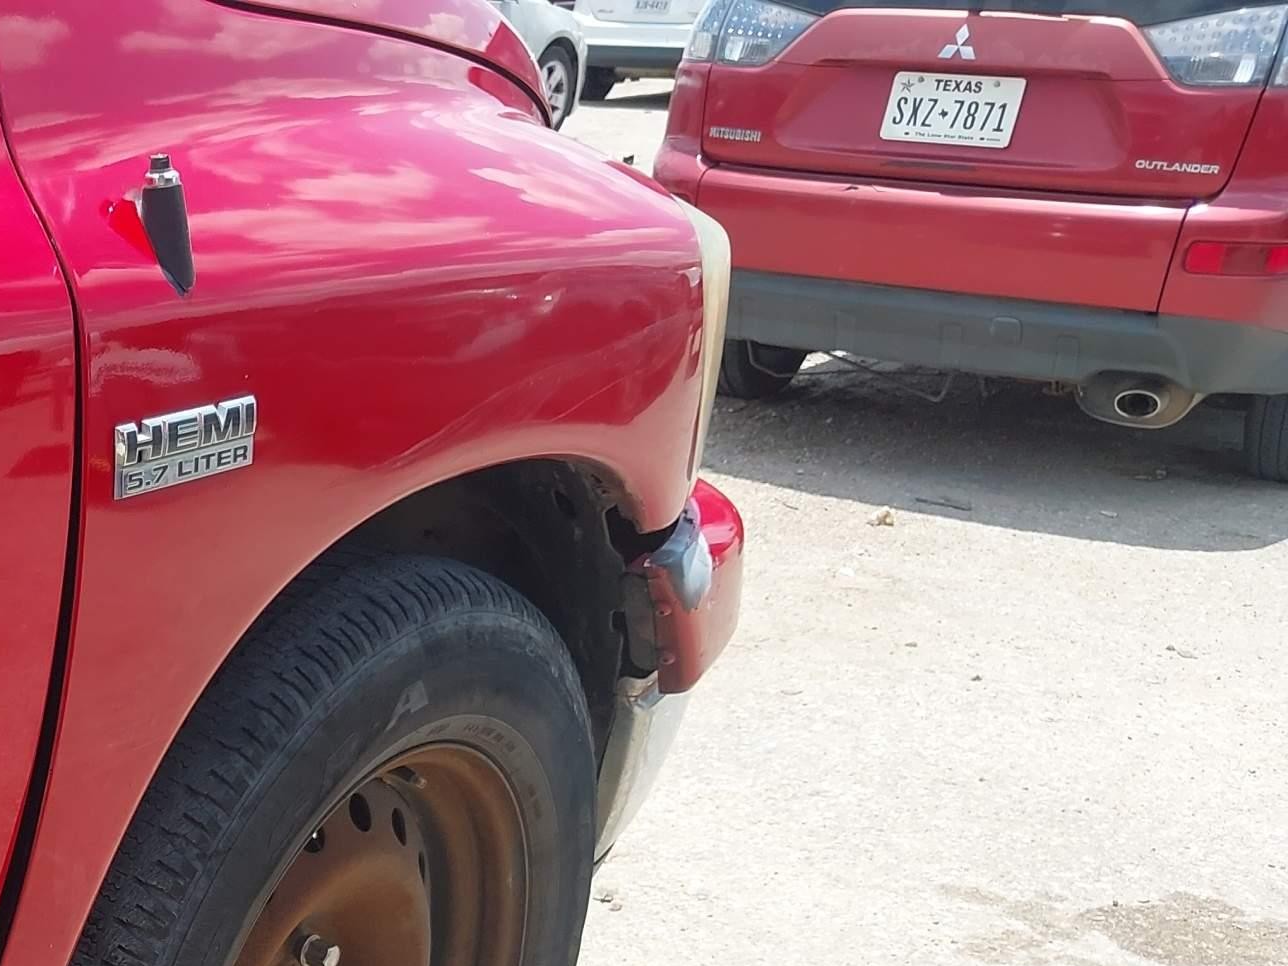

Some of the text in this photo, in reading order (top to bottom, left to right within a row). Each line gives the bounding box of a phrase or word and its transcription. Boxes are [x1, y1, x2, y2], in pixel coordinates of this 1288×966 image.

[934, 79, 983, 93] TEXAS
[709, 127, 761, 142] MITSUBISHI
[1135, 159, 1220, 174] OUTLANDER
[115, 395, 256, 466] HEMI
[127, 445, 248, 491] 5.7 LITER
